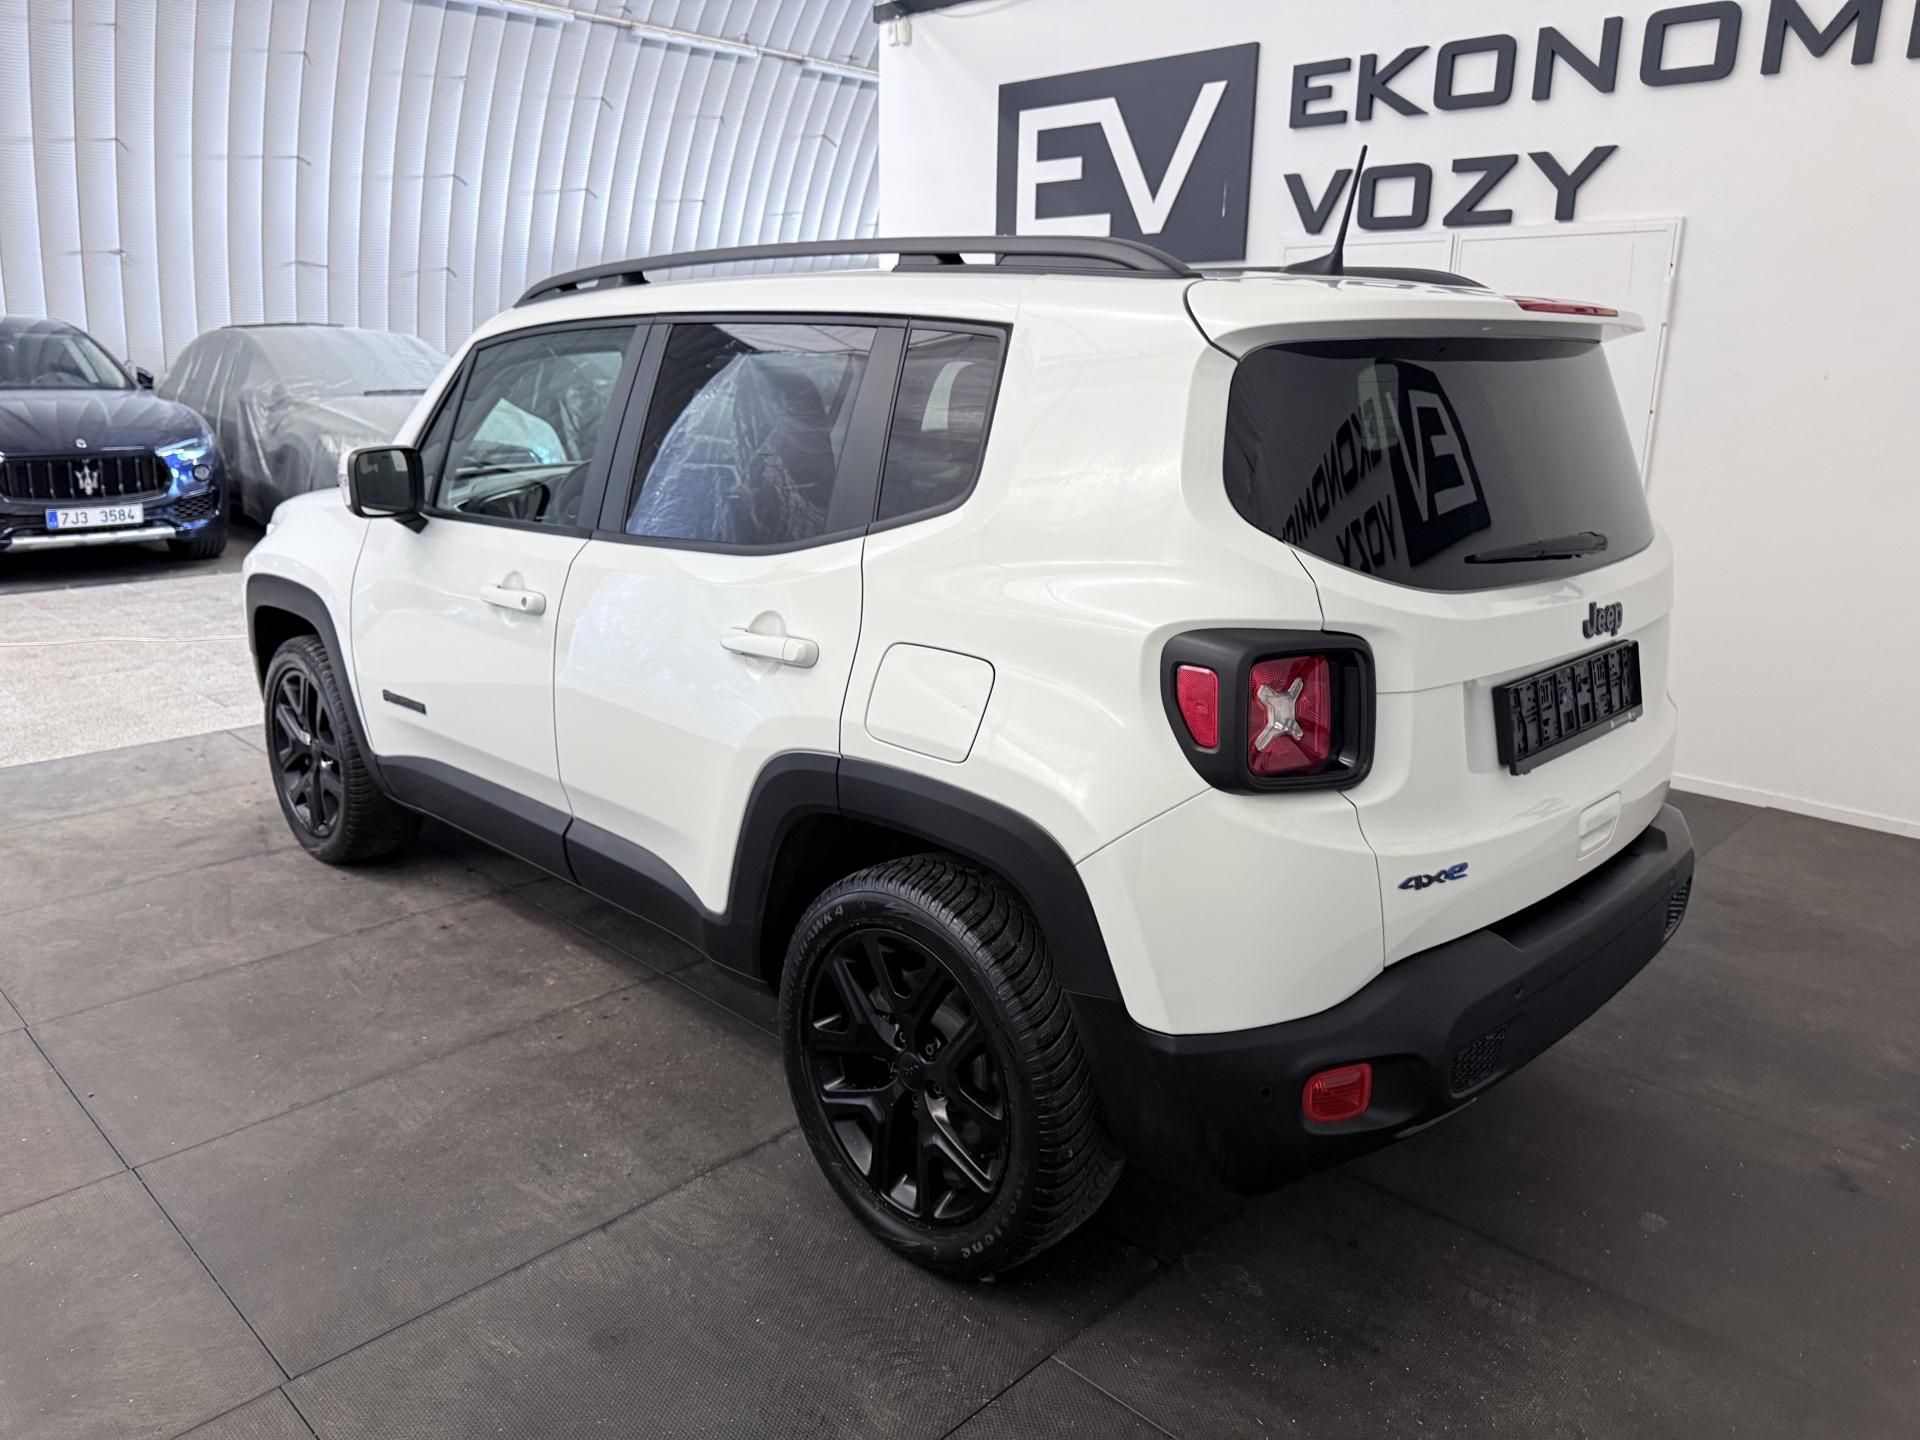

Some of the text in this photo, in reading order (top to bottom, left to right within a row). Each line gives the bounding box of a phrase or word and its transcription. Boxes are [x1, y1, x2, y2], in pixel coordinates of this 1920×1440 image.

[1017, 80, 1228, 237] EV
[1284, 145, 1618, 235] VOZY
[60, 512, 89, 525] 7J3
[100, 508, 135, 523] 3584
[1583, 602, 1623, 639] Jeep
